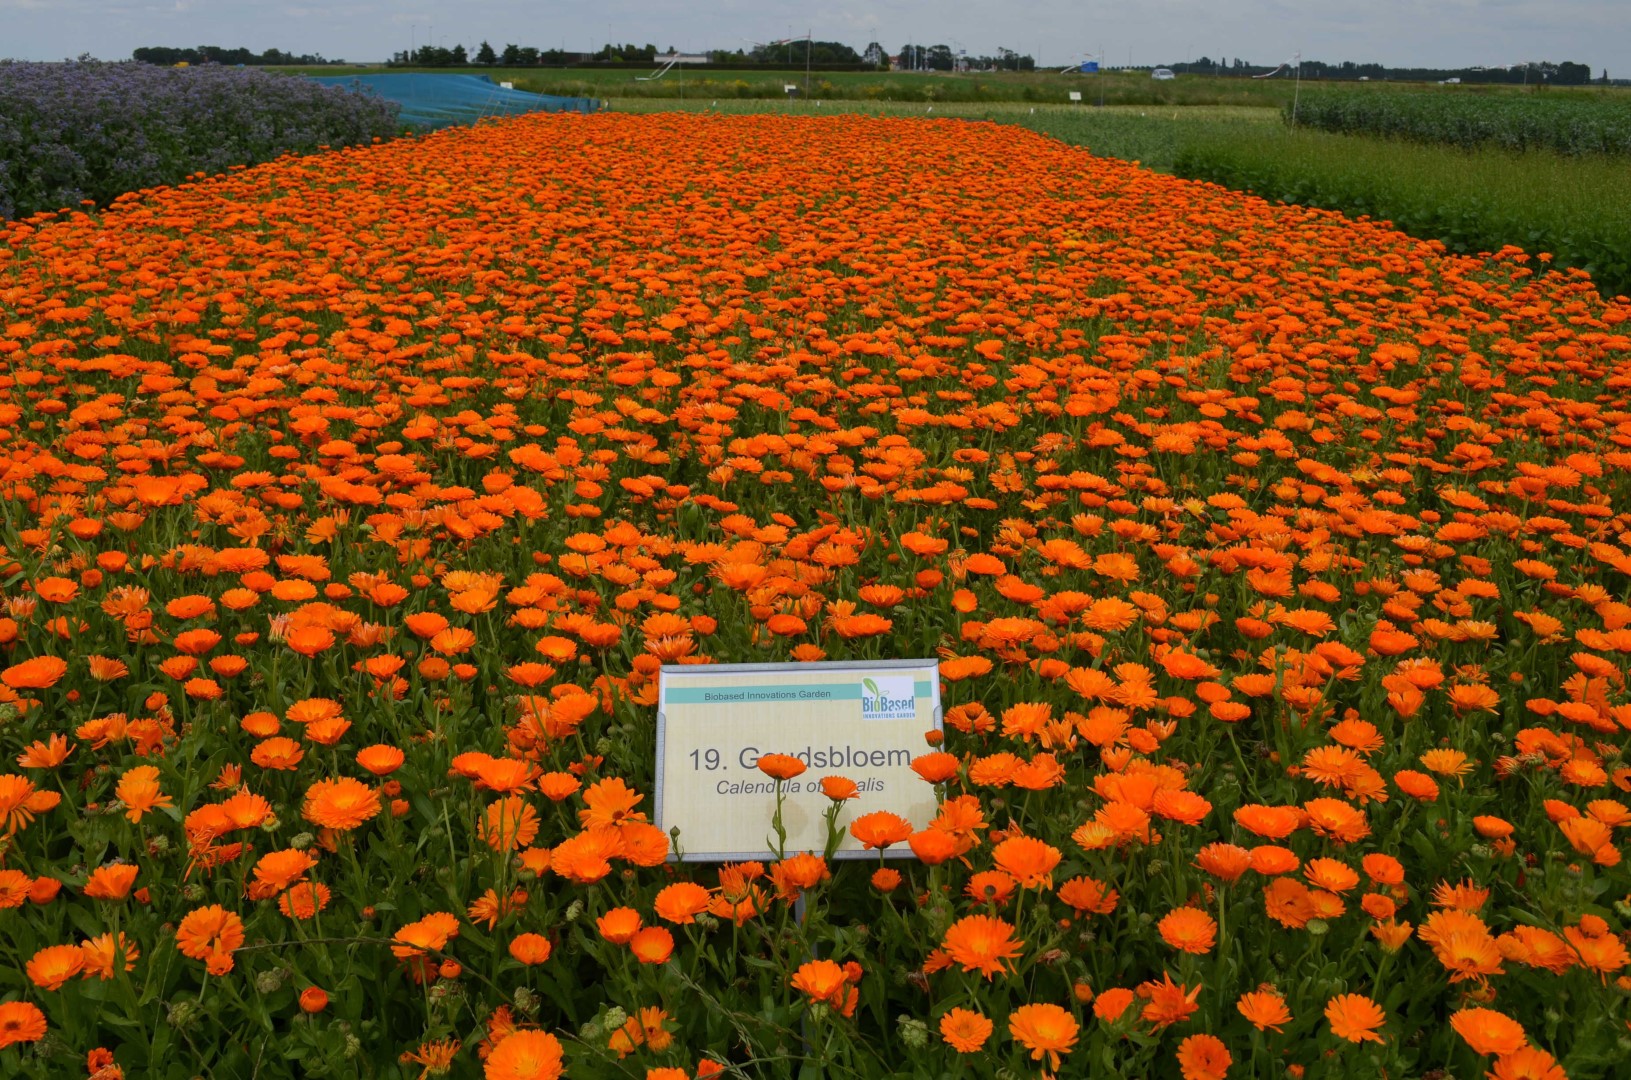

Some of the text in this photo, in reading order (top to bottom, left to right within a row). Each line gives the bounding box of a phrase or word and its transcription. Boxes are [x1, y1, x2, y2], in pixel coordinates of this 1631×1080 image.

[704, 689, 831, 702] Biobased Innovations Garden
[862, 695, 915, 713] BioBased
[690, 745, 911, 771] 19. Gdsbloem
